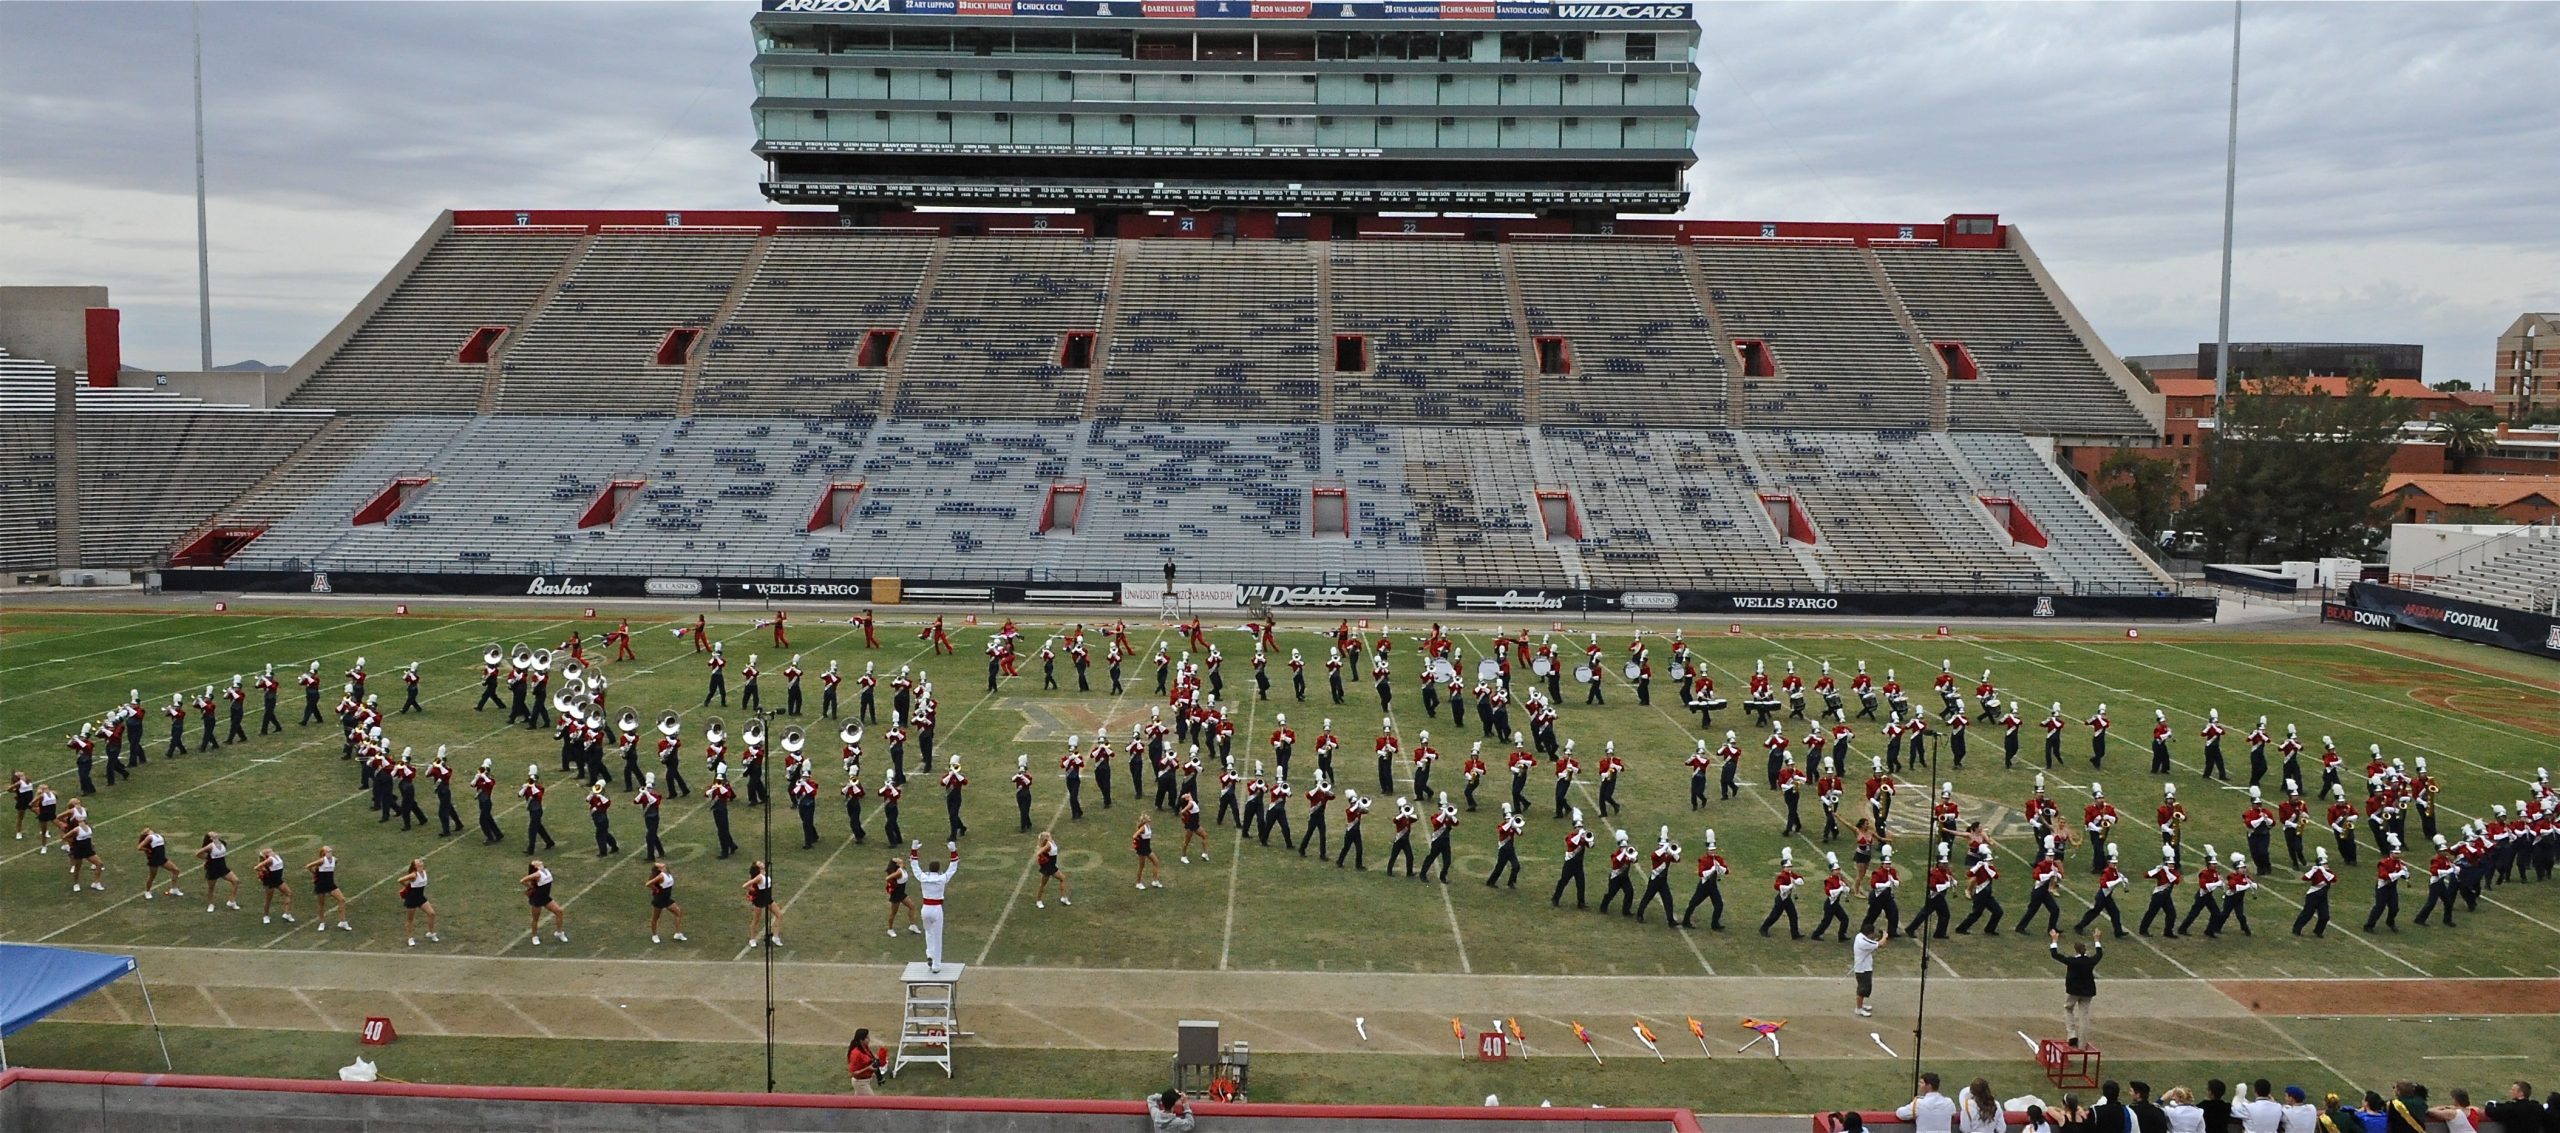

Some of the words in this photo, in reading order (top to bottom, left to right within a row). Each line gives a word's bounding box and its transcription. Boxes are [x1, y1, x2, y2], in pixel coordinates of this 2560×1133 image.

[775, 0, 890, 11] ARIZONA
[1558, 5, 1685, 18] WILDCATS
[1182, 220, 1193, 230] 21
[1403, 224, 1416, 233] 22
[1762, 228, 1775, 236] 24
[1900, 230, 1913, 238] 25
[527, 577, 592, 594] Bashas'
[755, 583, 806, 593] WELLS
[810, 585, 859, 595] FARGO
[1125, 589, 1158, 599] UNIVERSITY
[1201, 591, 1219, 600] BAND
[1220, 591, 1233, 600] DAY
[1733, 598, 1784, 607] WELLS
[1788, 598, 1837, 608] FARGO
[2326, 606, 2353, 620] BEAR
[2354, 611, 2390, 627] DOWN
[2403, 604, 2444, 618] ARIZONA
[2443, 611, 2499, 632] FOOTBALL
[364, 1021, 382, 1040] 40
[1482, 1038, 1502, 1056] 40
